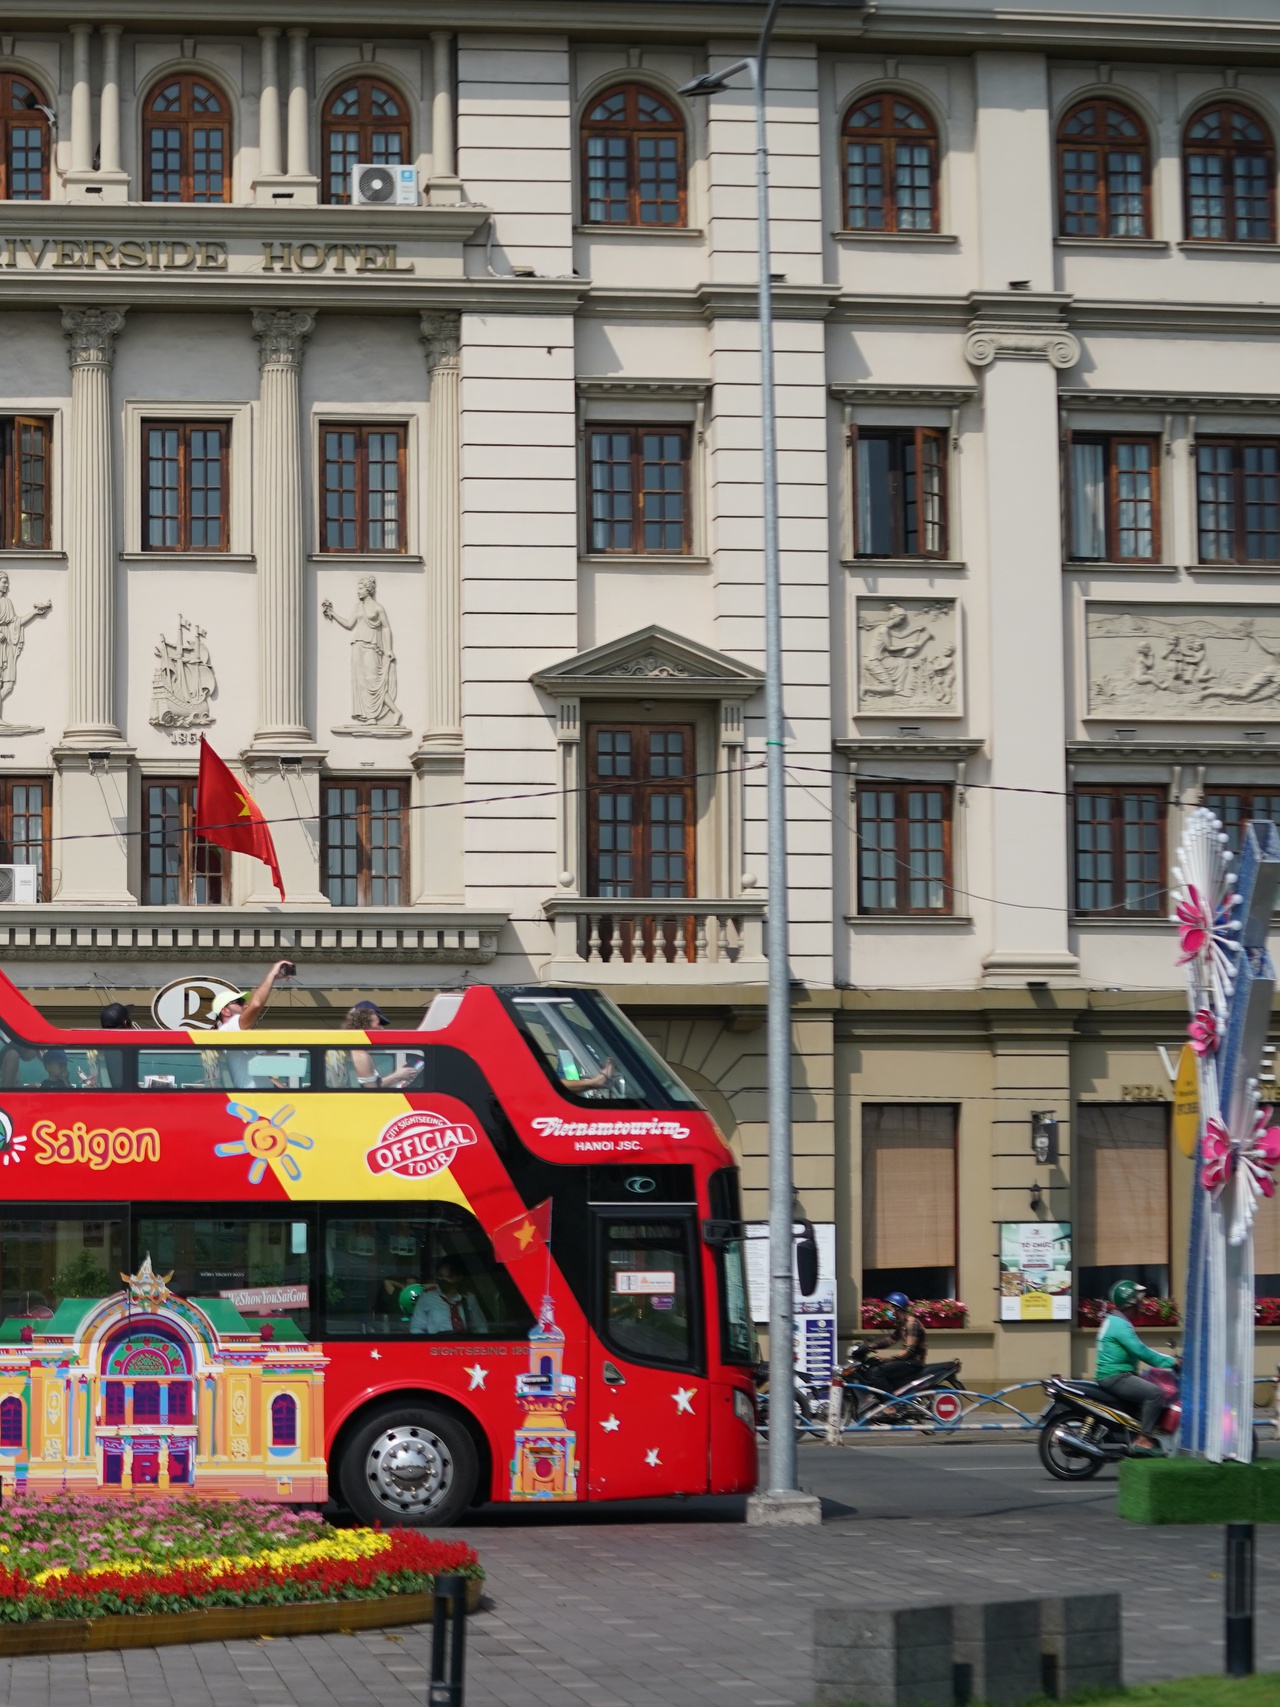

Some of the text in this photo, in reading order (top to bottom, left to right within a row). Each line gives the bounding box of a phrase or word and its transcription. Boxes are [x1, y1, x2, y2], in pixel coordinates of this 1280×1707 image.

[261, 242, 415, 272] HOTEL
[1121, 1084, 1166, 1099] PIZZA
[385, 1116, 444, 1141] CITY SIGHTSEEING
[531, 1116, 690, 1139] Vietnamtourism
[31, 1119, 161, 1170] Saigon
[376, 1127, 470, 1168] OFFICIAL
[574, 1141, 644, 1151] HANOI JSC.
[408, 1152, 450, 1175] TOUR
[430, 1346, 508, 1356] SIGHTSEEING
